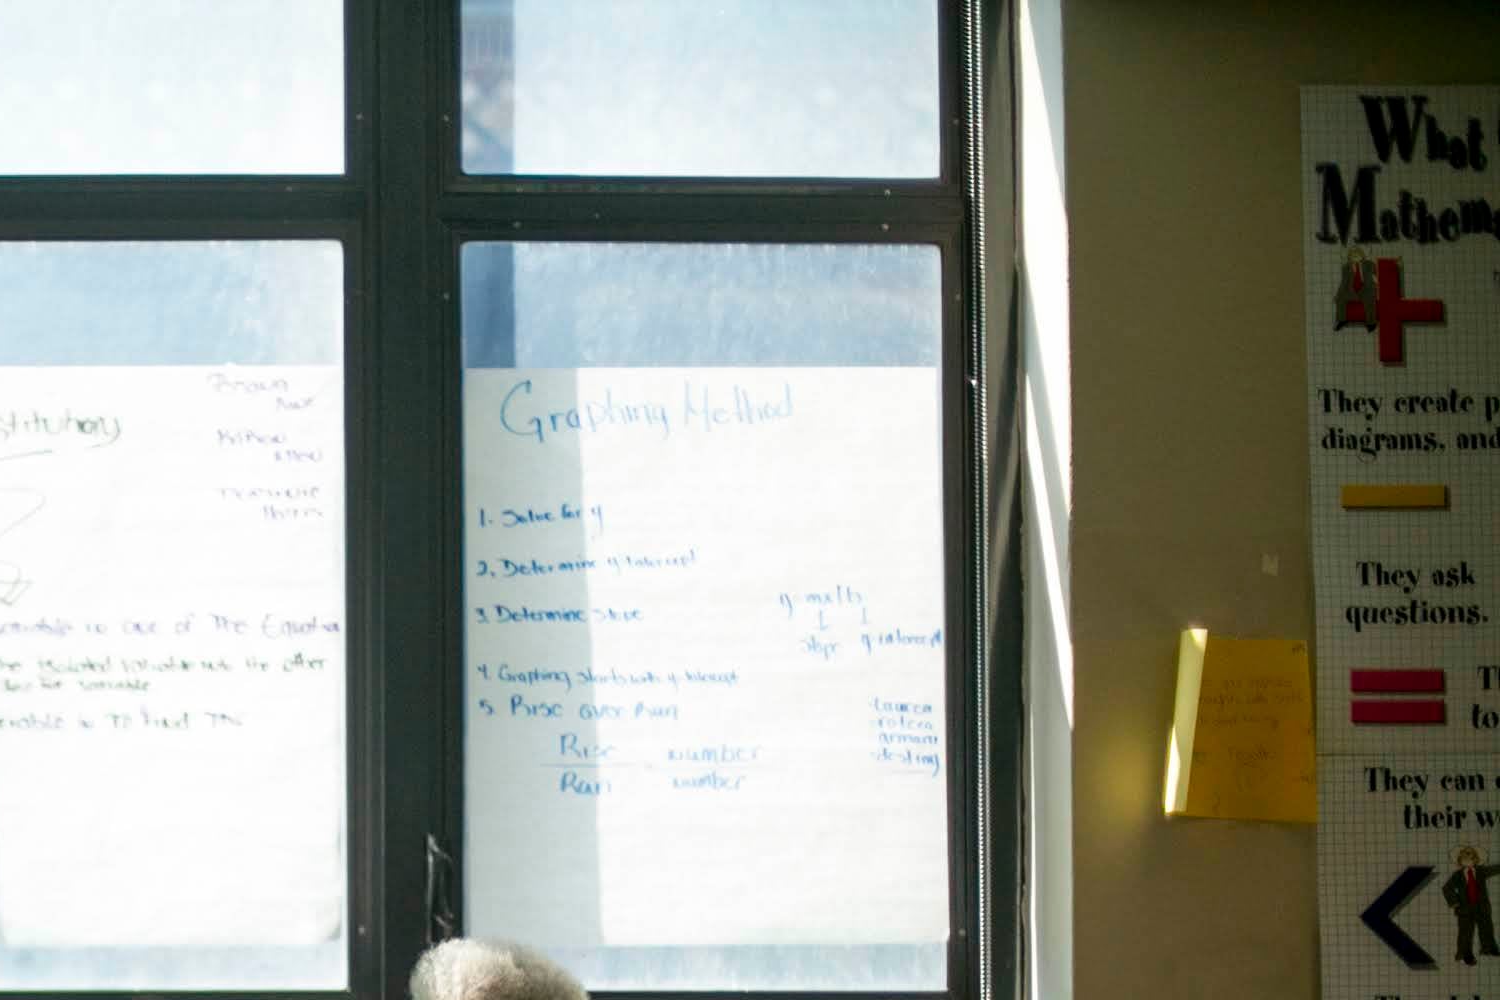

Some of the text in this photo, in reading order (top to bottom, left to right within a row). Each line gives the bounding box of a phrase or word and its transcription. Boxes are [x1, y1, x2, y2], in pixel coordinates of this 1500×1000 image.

[1359, 94, 1488, 172] What
[1317, 386, 1384, 423] They
[1394, 383, 1475, 415] create
[1355, 560, 1477, 595] They ask
[1345, 599, 1490, 633] questions.
[1476, 664, 1500, 691] T
[1472, 703, 1500, 730] to
[1364, 765, 1429, 800] They
[1441, 772, 1485, 792] can
[1404, 804, 1468, 830] their
